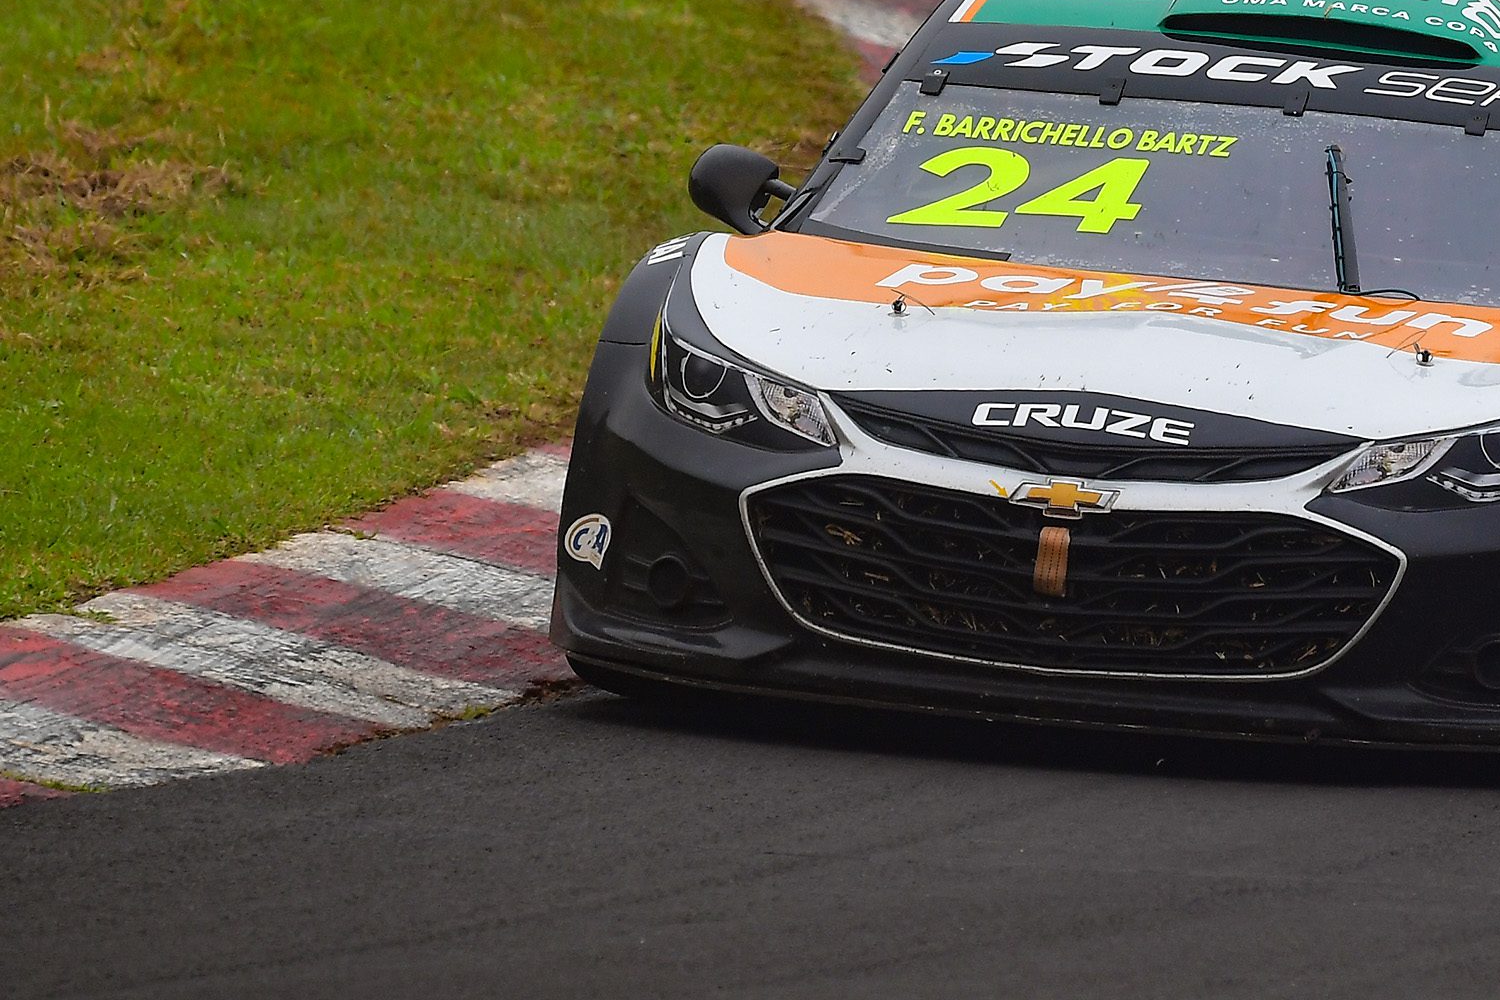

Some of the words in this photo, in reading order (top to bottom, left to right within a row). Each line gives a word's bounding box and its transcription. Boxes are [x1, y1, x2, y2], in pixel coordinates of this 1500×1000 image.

[995, 41, 1364, 89] STOCK
[902, 111, 924, 136] F.
[933, 115, 1134, 152] BARRICHELLO
[1139, 129, 1239, 159] BARTZ
[885, 145, 1152, 234] 24
[963, 299, 1073, 311] PAY
[1110, 301, 1223, 317] FOR
[1255, 318, 1374, 339] FUN
[972, 402, 1195, 446] CRUZE
